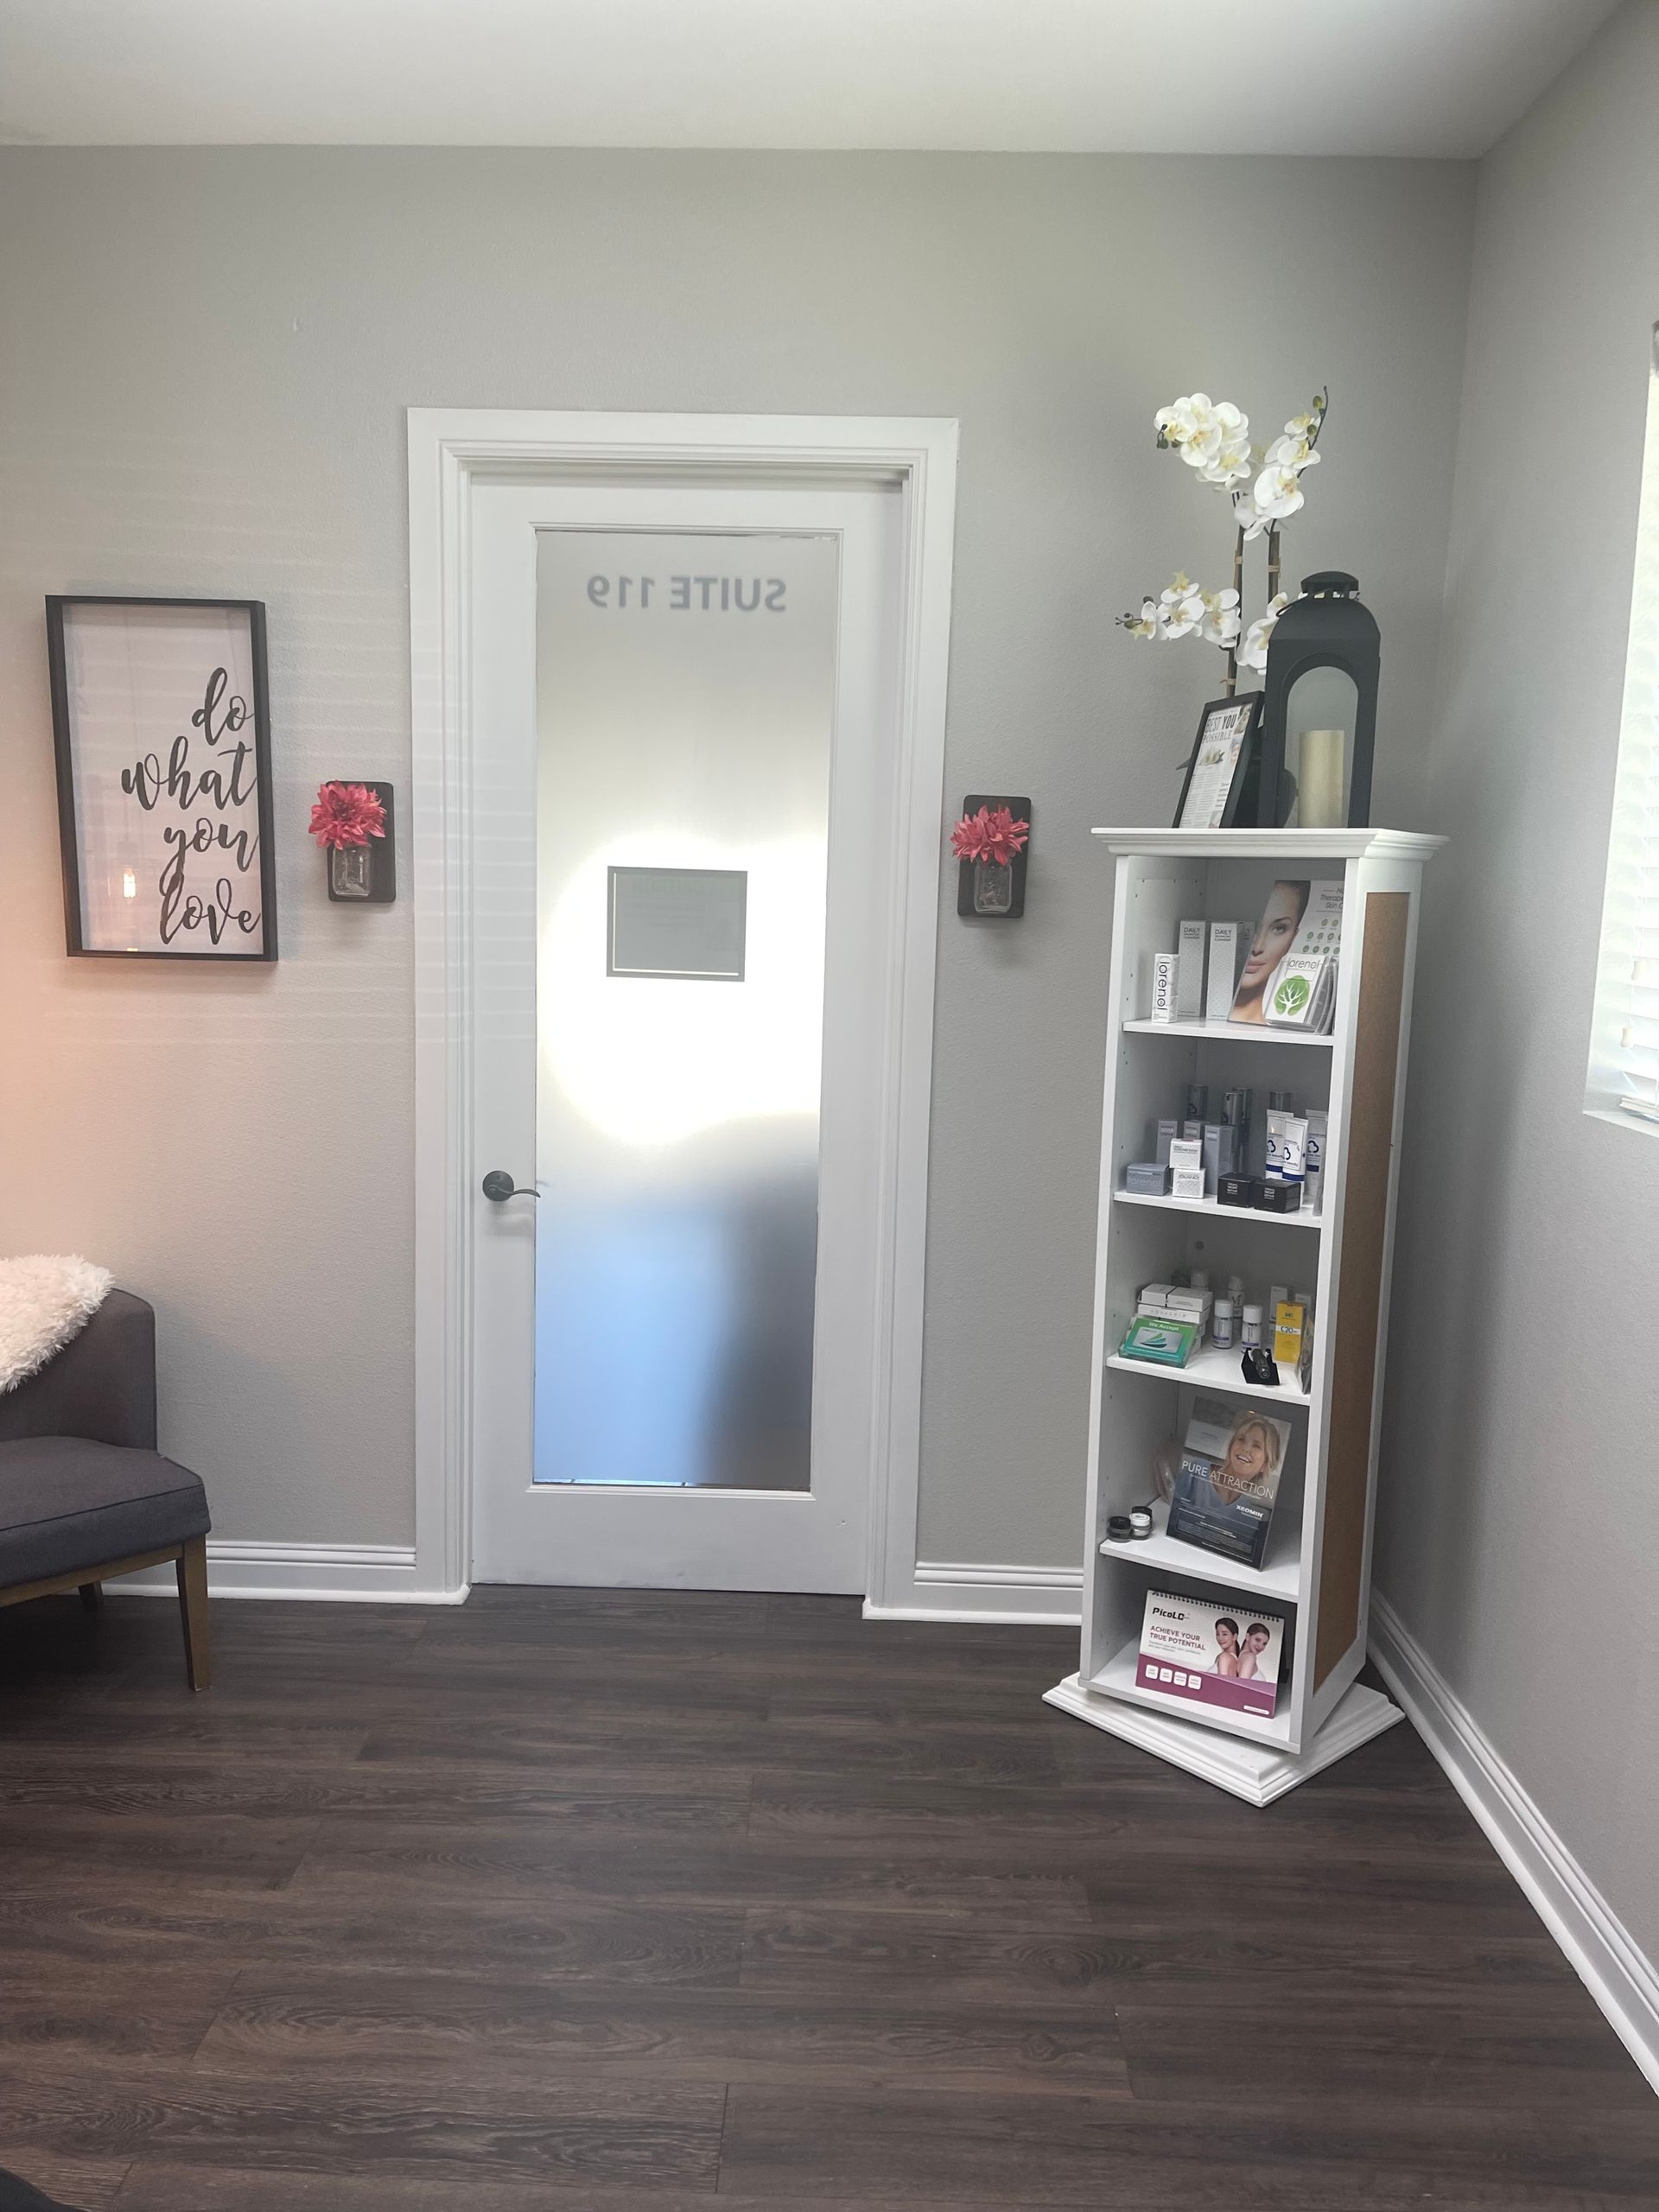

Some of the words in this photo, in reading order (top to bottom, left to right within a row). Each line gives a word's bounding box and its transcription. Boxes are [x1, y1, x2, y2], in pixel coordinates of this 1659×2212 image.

[191, 667, 254, 746] do
[1222, 714, 1237, 730] YOU
[121, 735, 258, 811] what
[159, 817, 259, 897] you
[159, 869, 261, 945] love
[1156, 961, 1171, 1011] lorenol
[1181, 1460, 1208, 1477] PURE
[1209, 1470, 1274, 1500] ATTRACTION
[1236, 1504, 1263, 1518] XEOMIN
[1150, 1625, 1179, 1637] ACHIEVE
[1181, 1632, 1201, 1642] YOUR
[1150, 1632, 1167, 1642] TRUE
[1168, 1637, 1206, 1651] POTENTIAL
